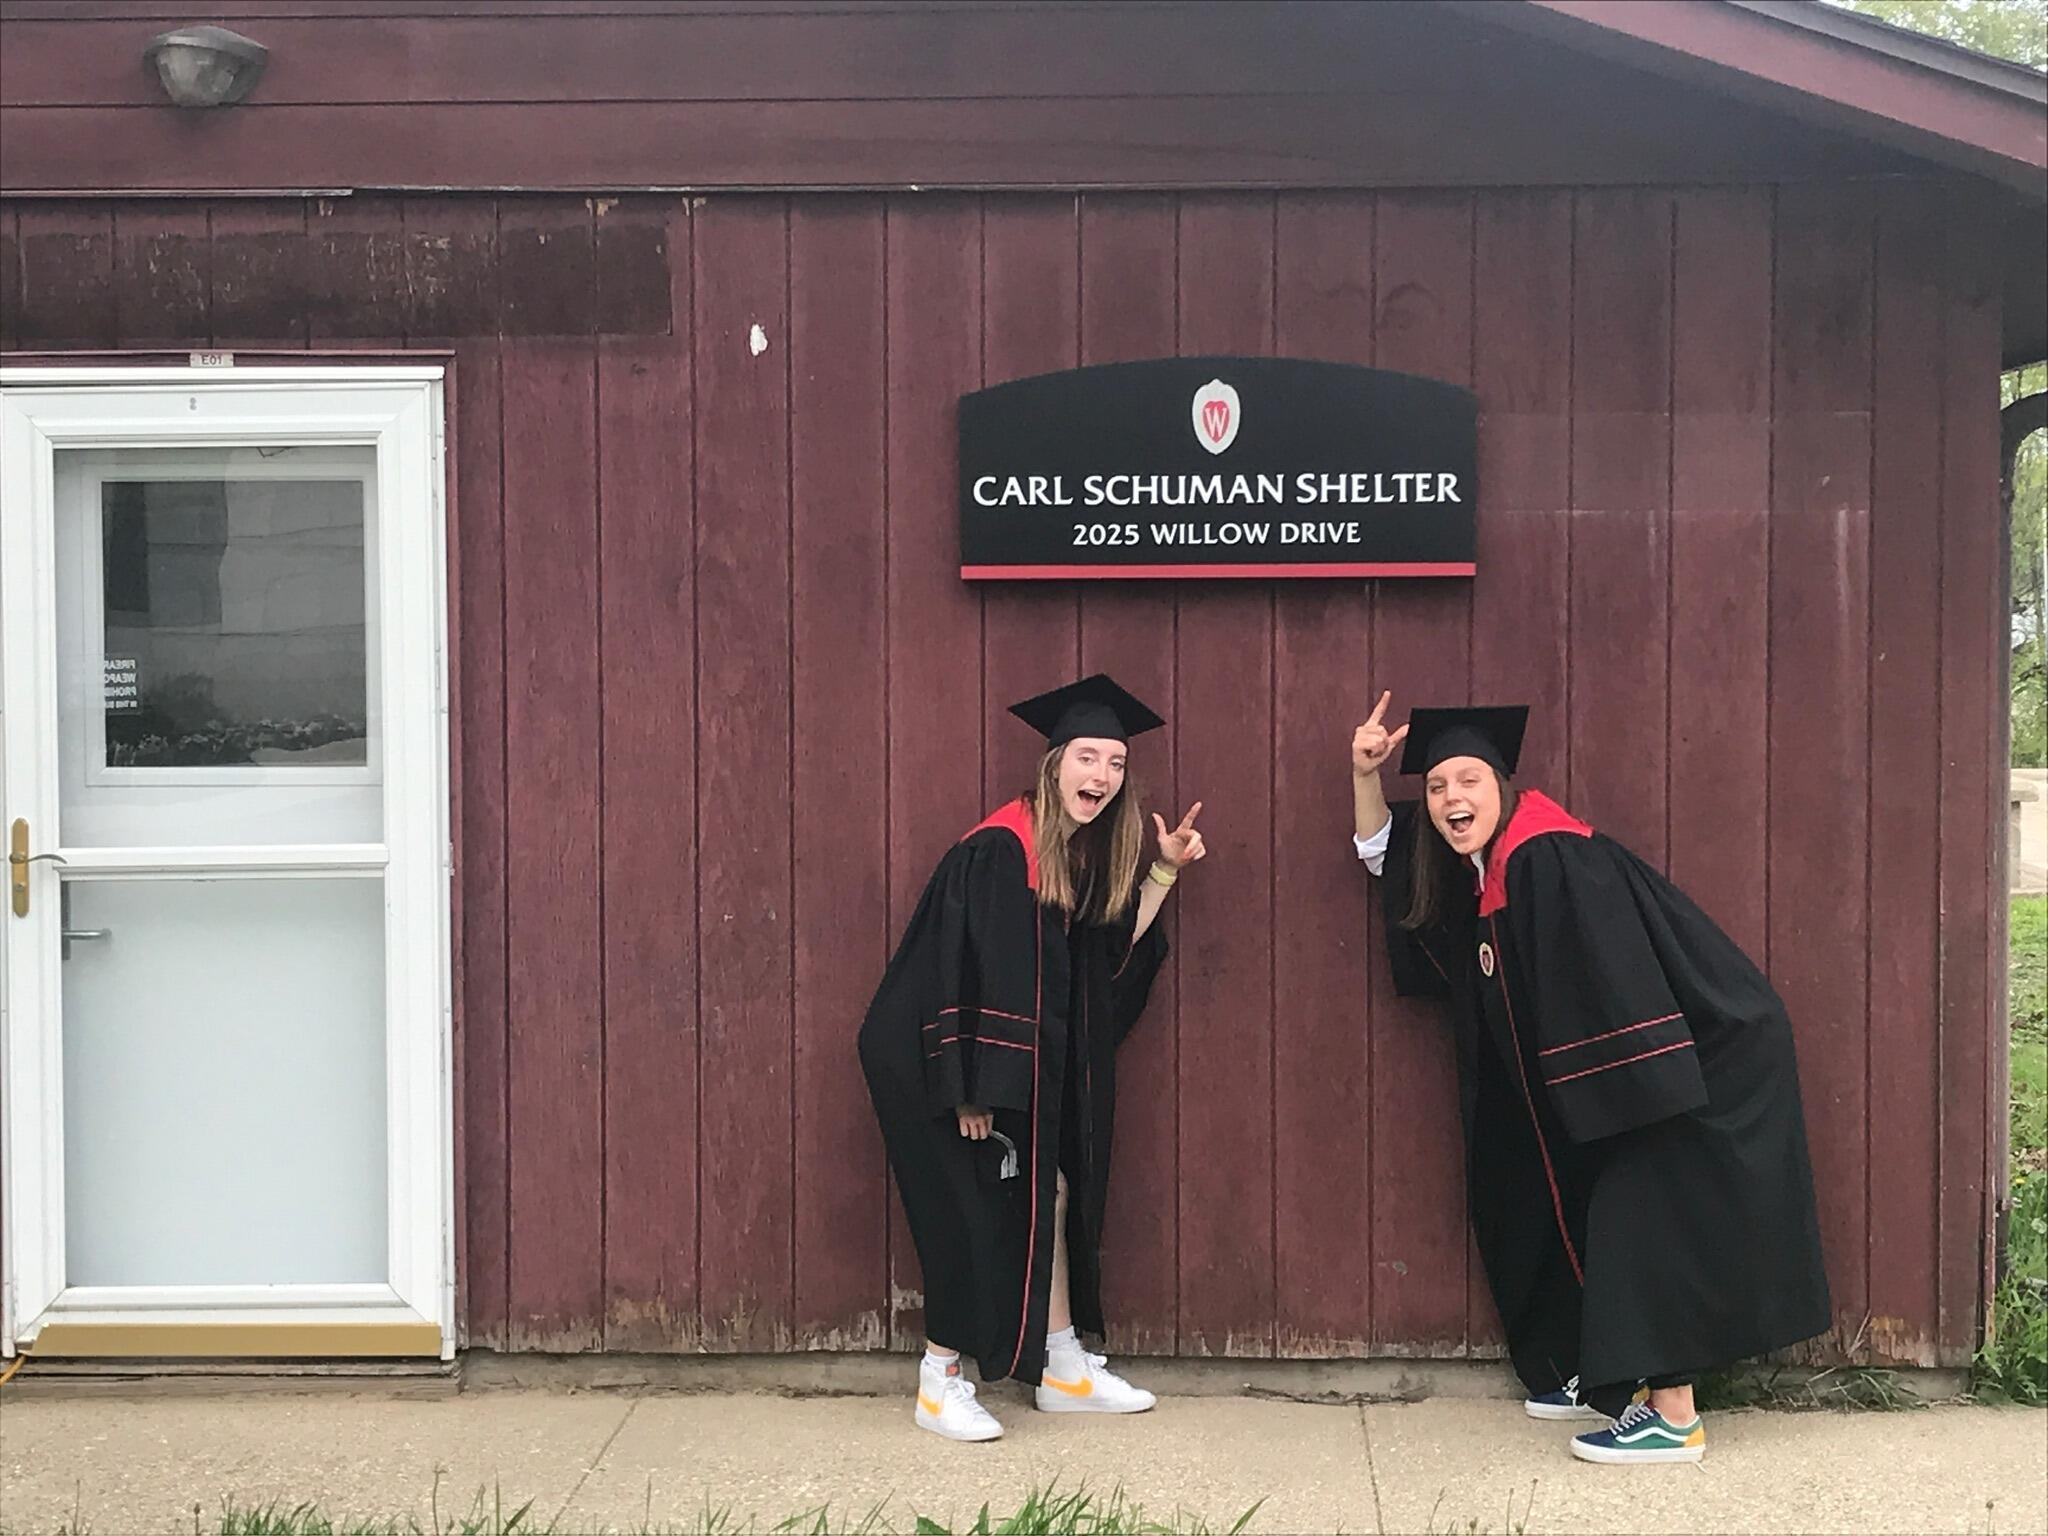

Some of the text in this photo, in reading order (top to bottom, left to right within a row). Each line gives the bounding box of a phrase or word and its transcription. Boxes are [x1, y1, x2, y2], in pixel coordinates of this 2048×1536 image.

[201, 354, 222, 366] E01
[1204, 406, 1228, 438] W
[973, 472, 1462, 506] CARL SCHUMAN SHELTER
[1072, 522, 1361, 546] 2025 WILLOW DRIVE
